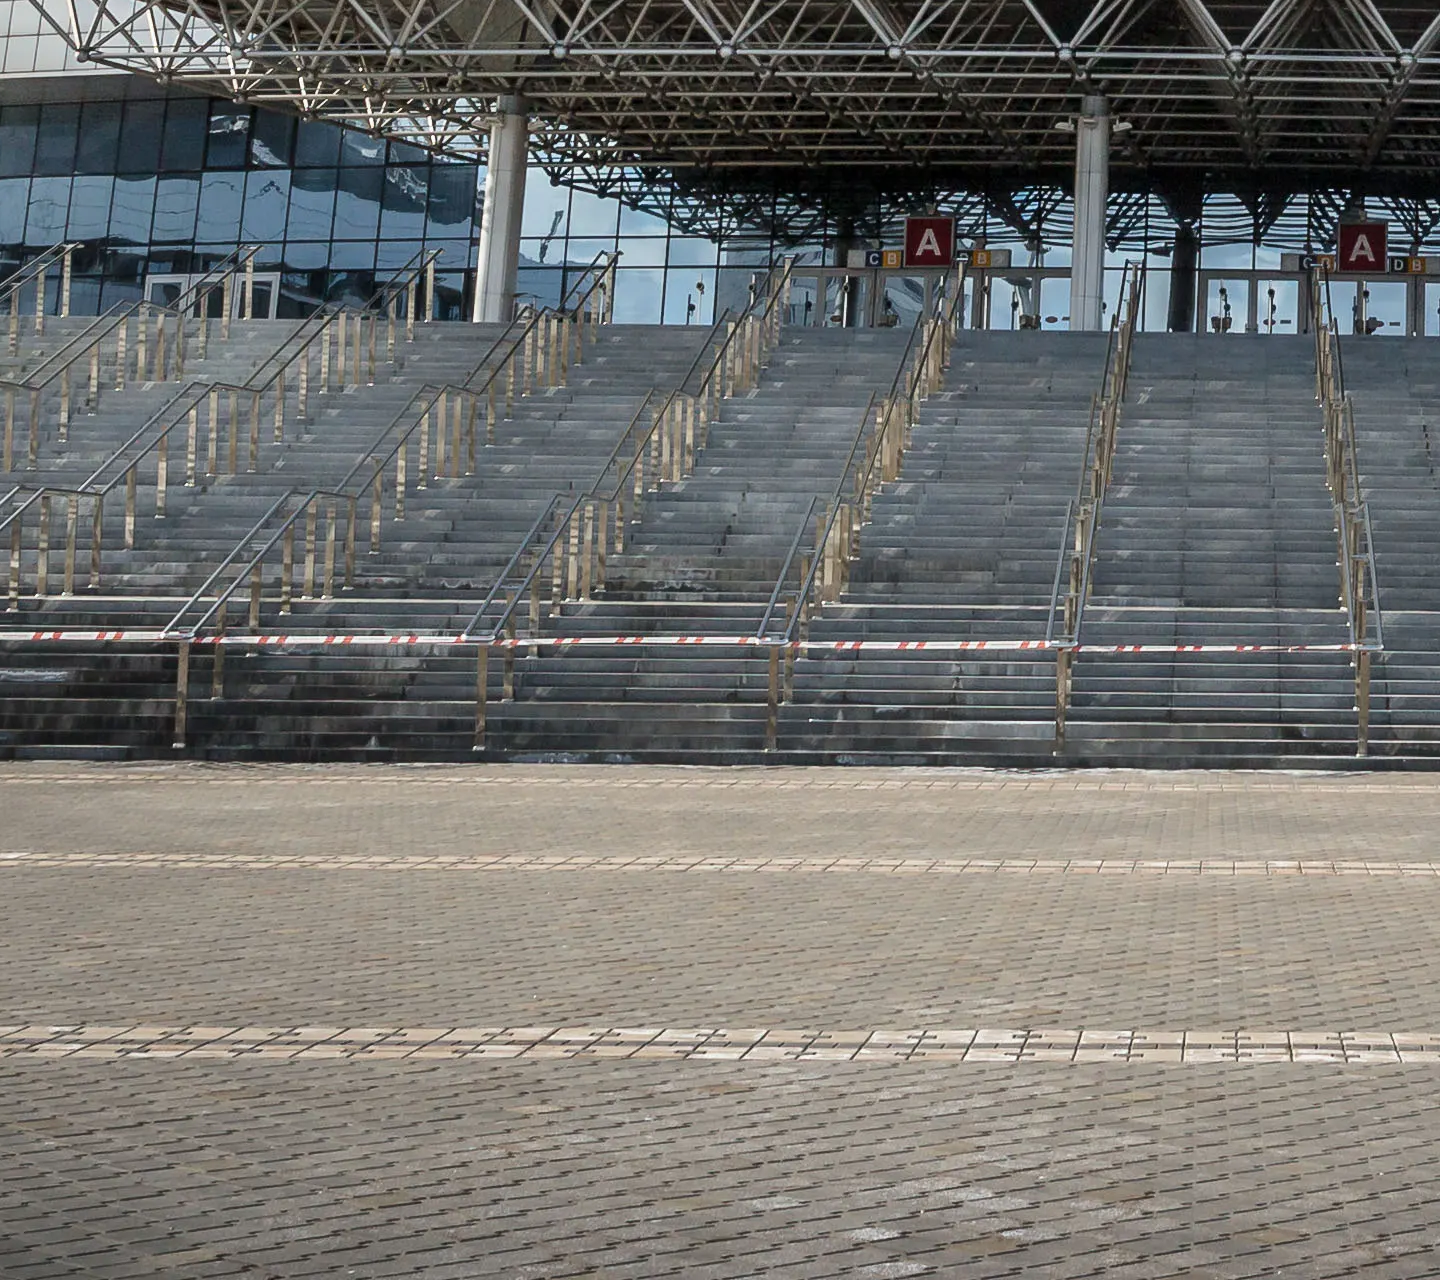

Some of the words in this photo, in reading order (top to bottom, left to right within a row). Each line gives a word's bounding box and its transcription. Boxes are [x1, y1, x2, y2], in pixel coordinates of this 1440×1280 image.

[915, 228, 942, 256] A
[1349, 234, 1376, 262] A
[869, 254, 880, 265] C
[888, 254, 897, 265] B
